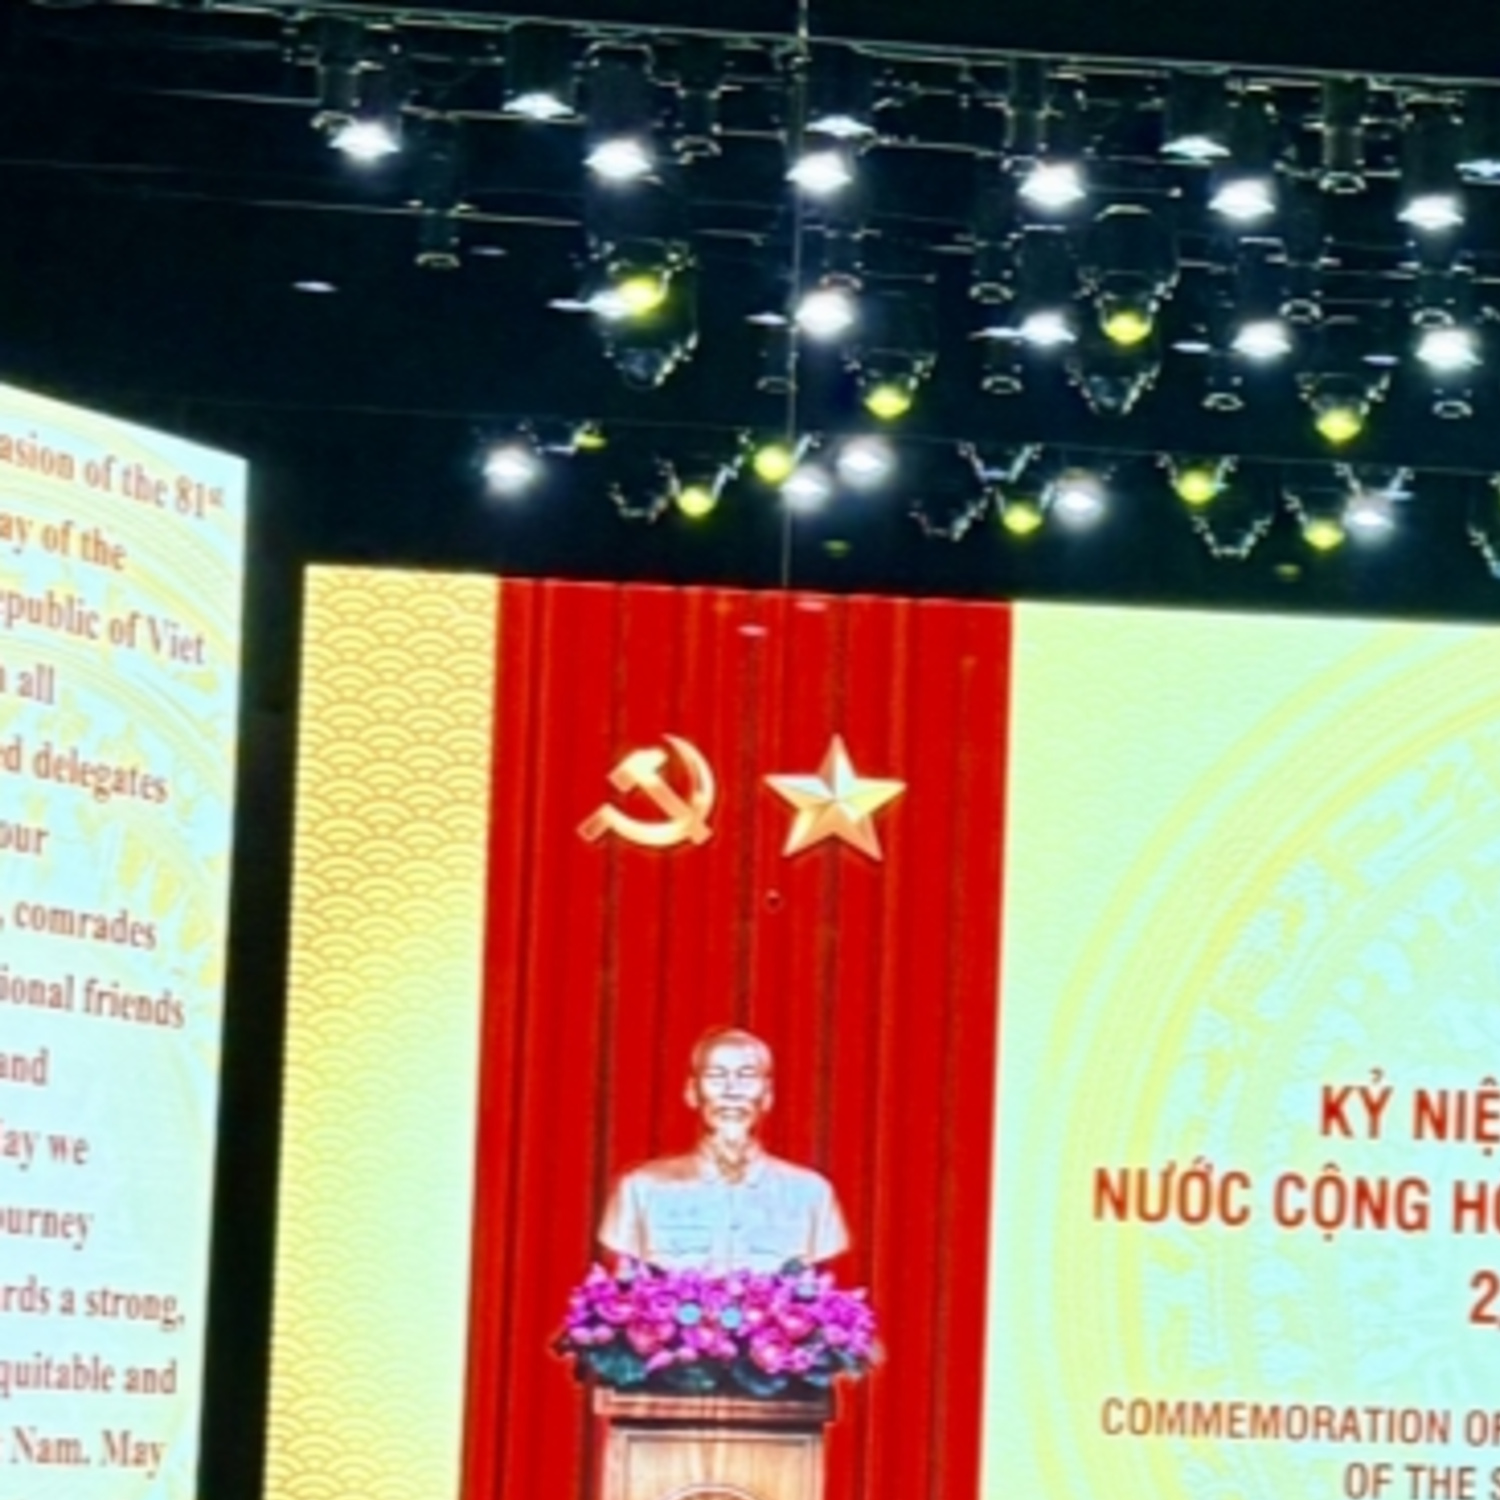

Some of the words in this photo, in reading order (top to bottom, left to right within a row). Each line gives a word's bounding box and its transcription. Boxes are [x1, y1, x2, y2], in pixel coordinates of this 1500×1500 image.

[84, 454, 116, 492] of
[122, 463, 167, 508] the
[41, 519, 74, 556] of
[81, 527, 127, 571] the
[109, 611, 140, 648] of
[147, 615, 205, 665] Viet
[17, 663, 55, 705] all
[33, 741, 167, 804] delegates
[14, 902, 157, 950] comrades
[85, 977, 186, 1029] friends
[1320, 1068, 1393, 1140] KỶ
[0, 1118, 40, 1172] ay
[48, 1134, 89, 1165] we
[1093, 1155, 1251, 1226] NƯỚC
[1273, 1162, 1430, 1242] CỘNG
[60, 1288, 76, 1315] a
[85, 1286, 185, 1333] strong,
[125, 1358, 177, 1394] and
[1101, 1397, 1451, 1446] COMMEMORATION
[11, 1426, 90, 1465] Nam.
[100, 1429, 166, 1480] May
[1343, 1462, 1393, 1500] OF
